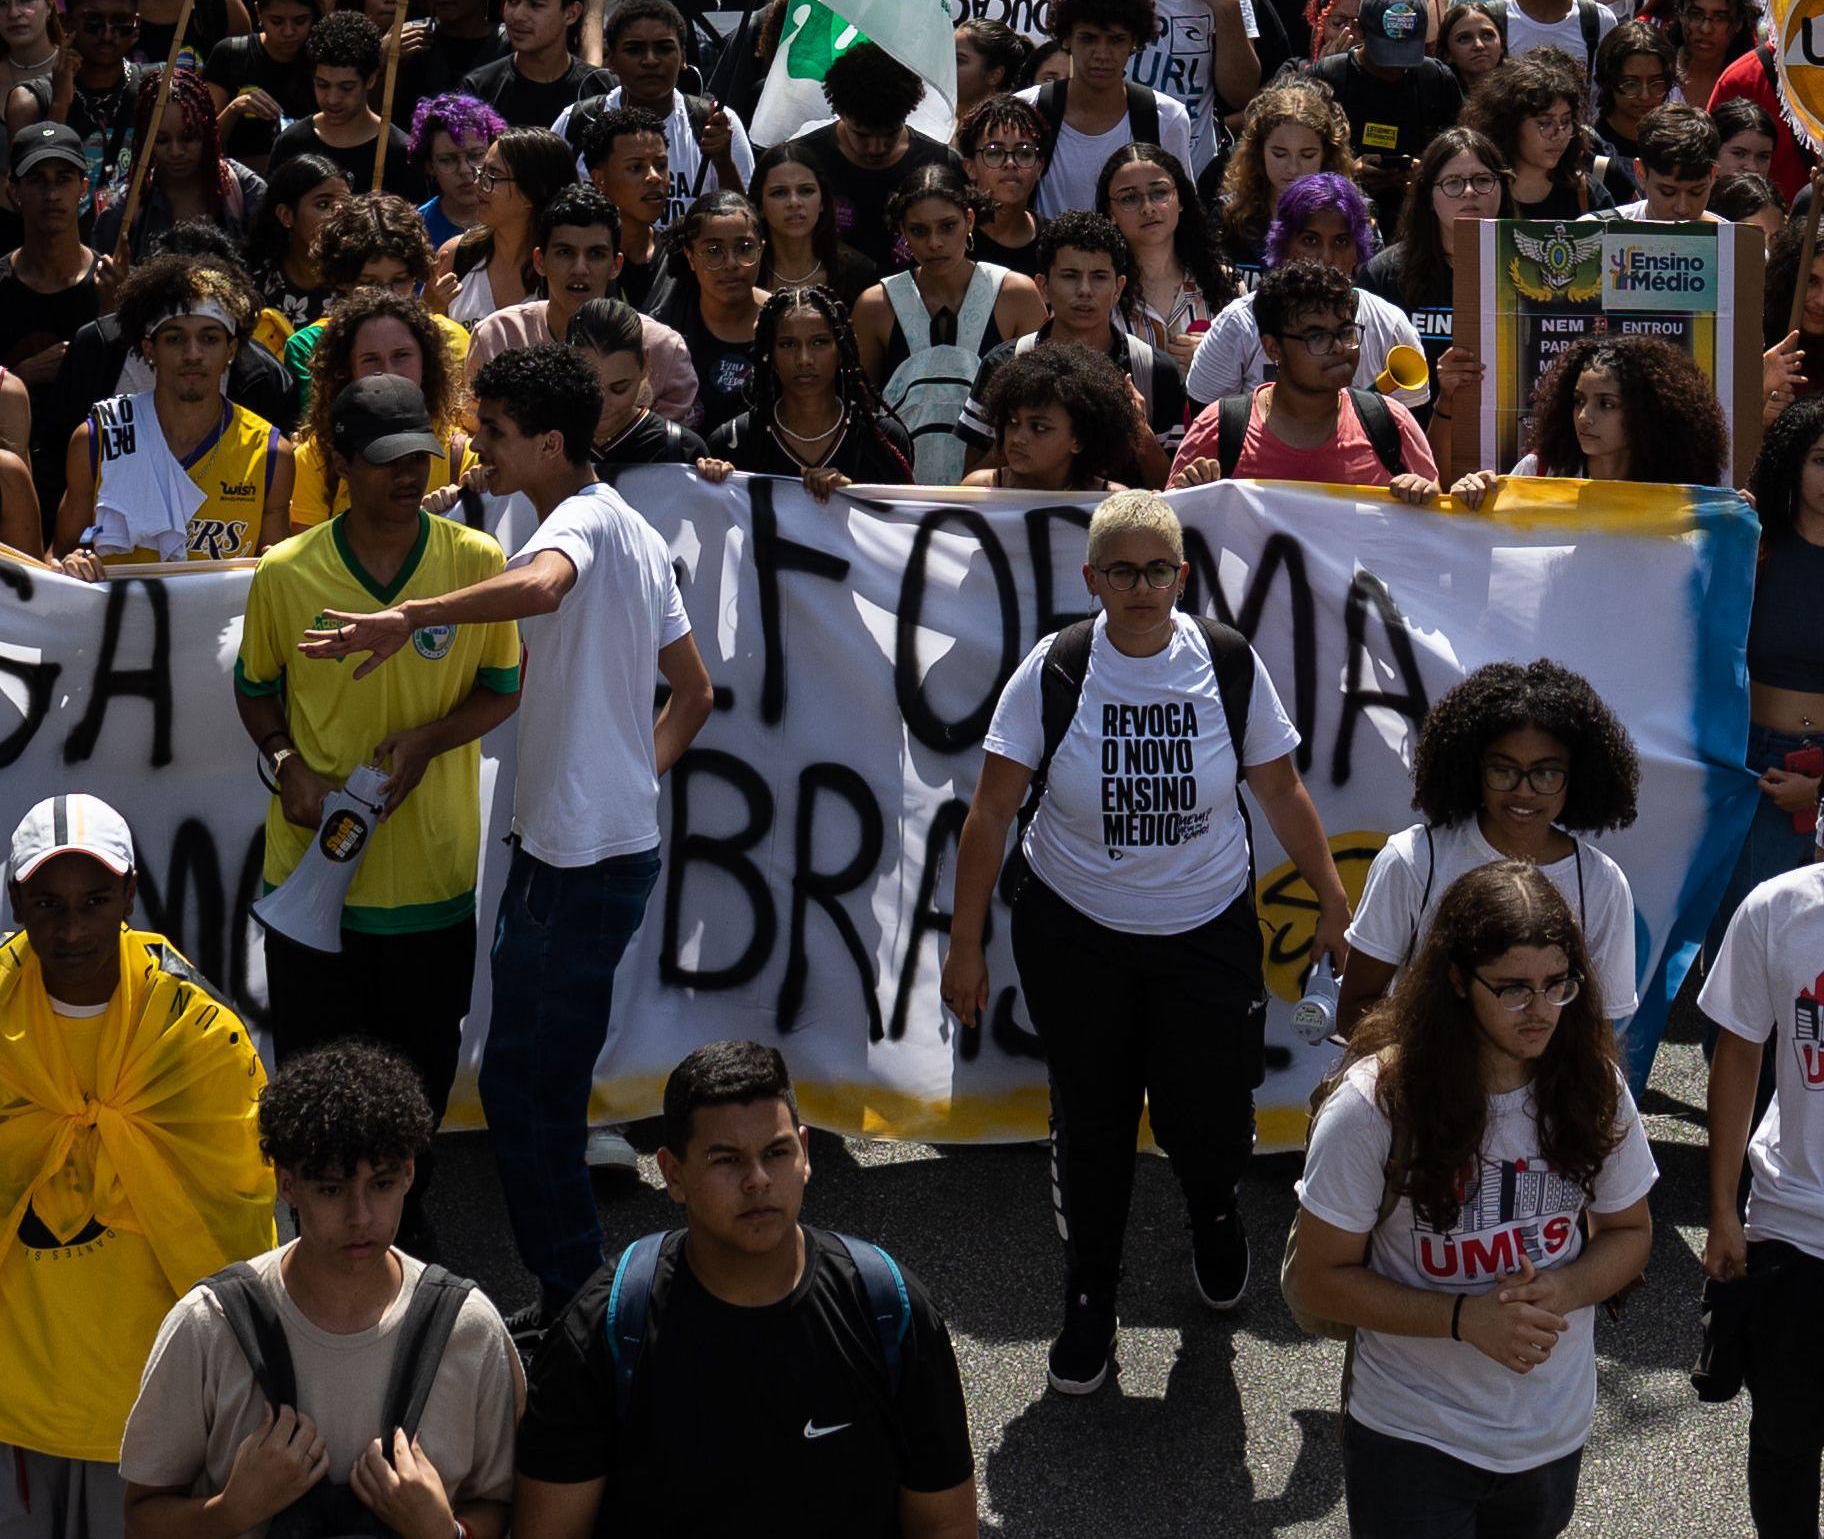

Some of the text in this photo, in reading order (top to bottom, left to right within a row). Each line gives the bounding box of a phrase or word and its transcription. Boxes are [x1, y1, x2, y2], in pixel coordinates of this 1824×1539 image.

[1131, 50, 1205, 95] URL
[1631, 251, 1705, 272] Ensino
[1630, 271, 1706, 293] Médio
[1541, 317, 1684, 336] NEM ENTROU
[1540, 340, 1579, 354] PAR
[220, 480, 256, 496] wish
[1103, 702, 1199, 738] REVOGA
[1102, 738, 1194, 775] O NOVO
[1102, 776, 1197, 812] ENSINO
[1103, 809, 1181, 846] MÉDIO
[1420, 1213, 1572, 1284] UMES
